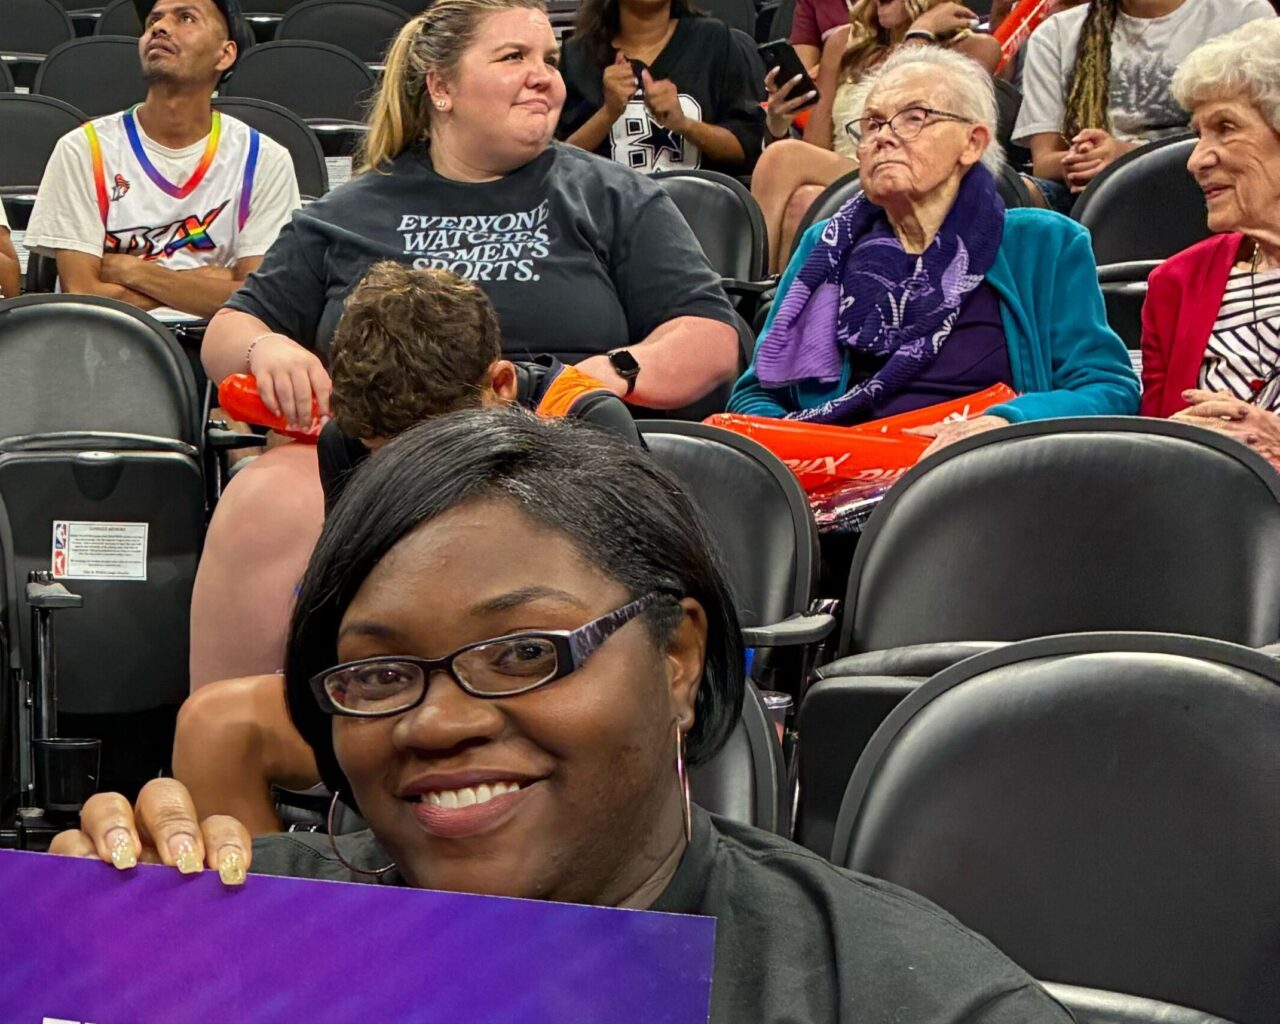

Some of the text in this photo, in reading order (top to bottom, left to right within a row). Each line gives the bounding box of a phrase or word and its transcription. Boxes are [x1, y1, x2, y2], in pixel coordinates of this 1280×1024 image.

[396, 198, 550, 233] EVERYONE
[403, 224, 551, 252] WATCHES
[403, 241, 551, 262] OMEN'S
